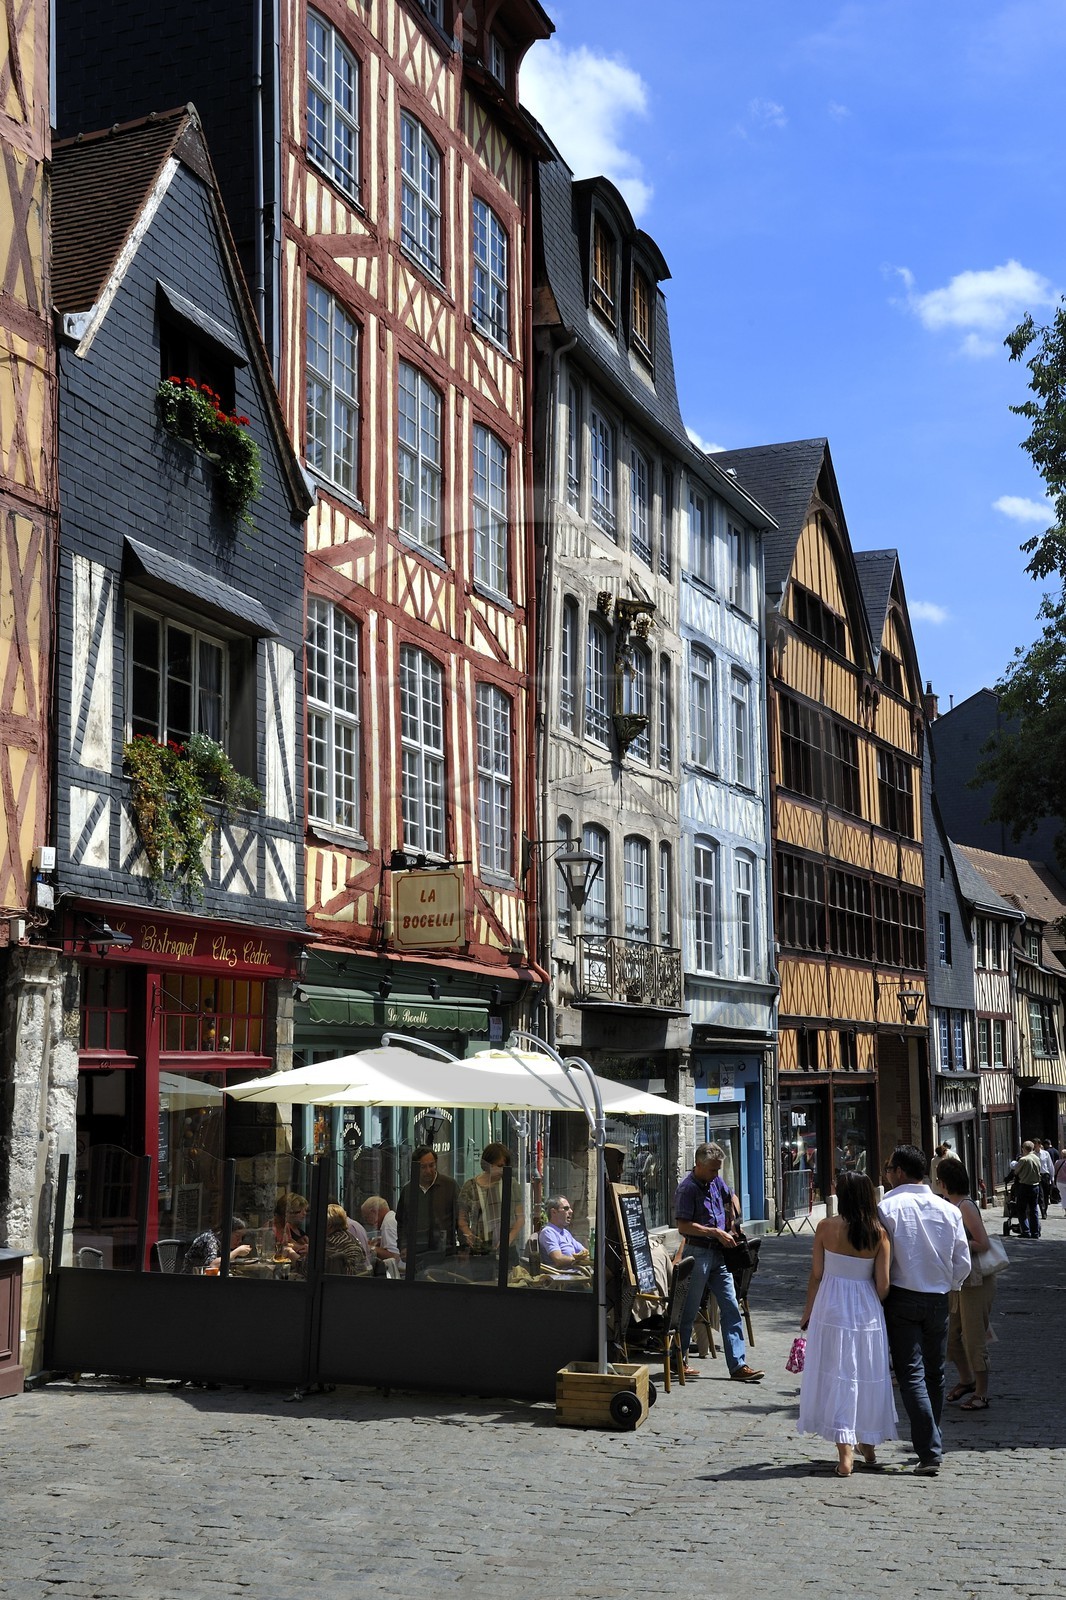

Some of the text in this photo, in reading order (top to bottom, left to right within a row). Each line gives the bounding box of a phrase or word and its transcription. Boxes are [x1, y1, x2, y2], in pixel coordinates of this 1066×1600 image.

[420, 889, 436, 903] LA
[403, 913, 455, 929] BOCELLI
[141, 924, 198, 960] Bistroquet
[212, 935, 238, 967] Chez
[243, 940, 272, 965] Cédric
[387, 1007, 429, 1024] La Bocelli
